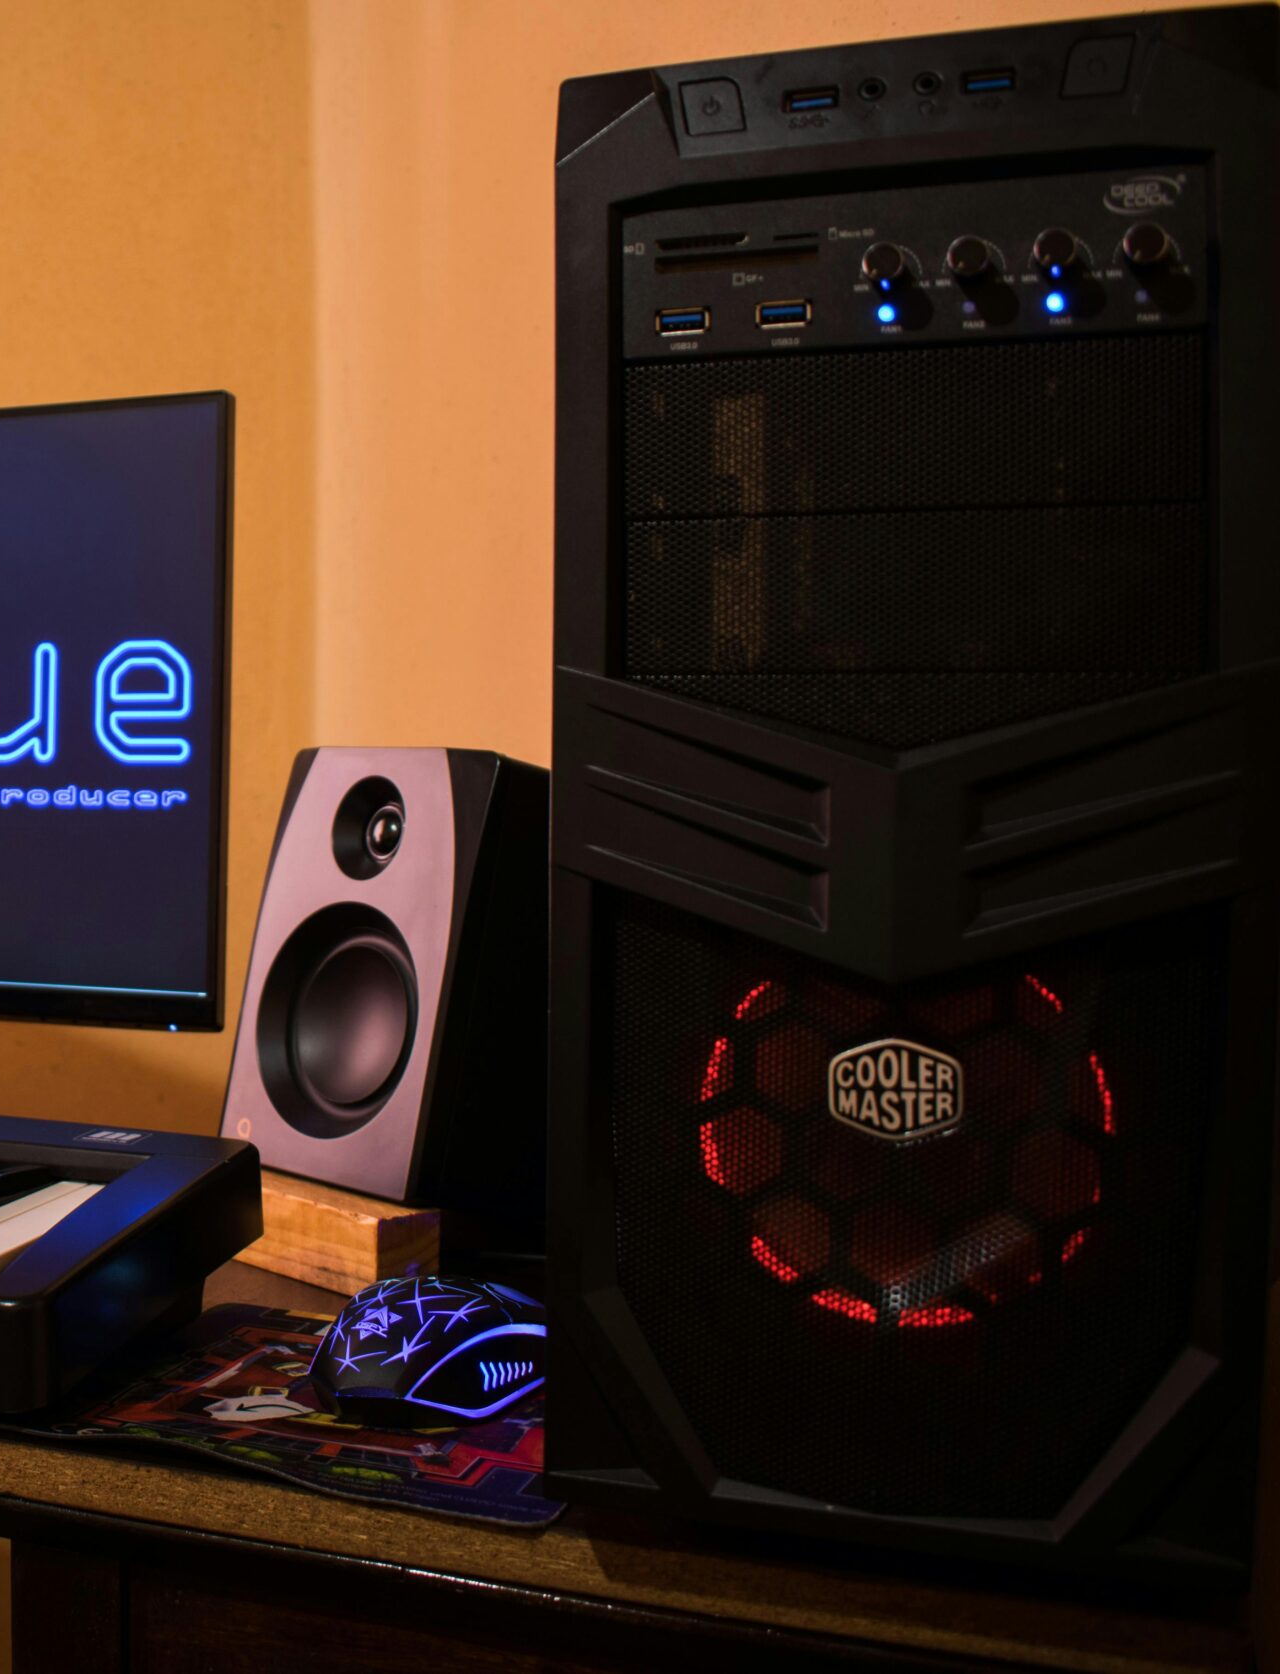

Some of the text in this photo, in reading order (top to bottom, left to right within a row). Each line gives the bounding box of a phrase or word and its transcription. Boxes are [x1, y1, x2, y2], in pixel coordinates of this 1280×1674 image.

[1110, 181, 1160, 197] DEEP
[1123, 192, 1175, 208] COOL
[835, 1048, 954, 1091] COOLER
[837, 1088, 954, 1132] MASTER
